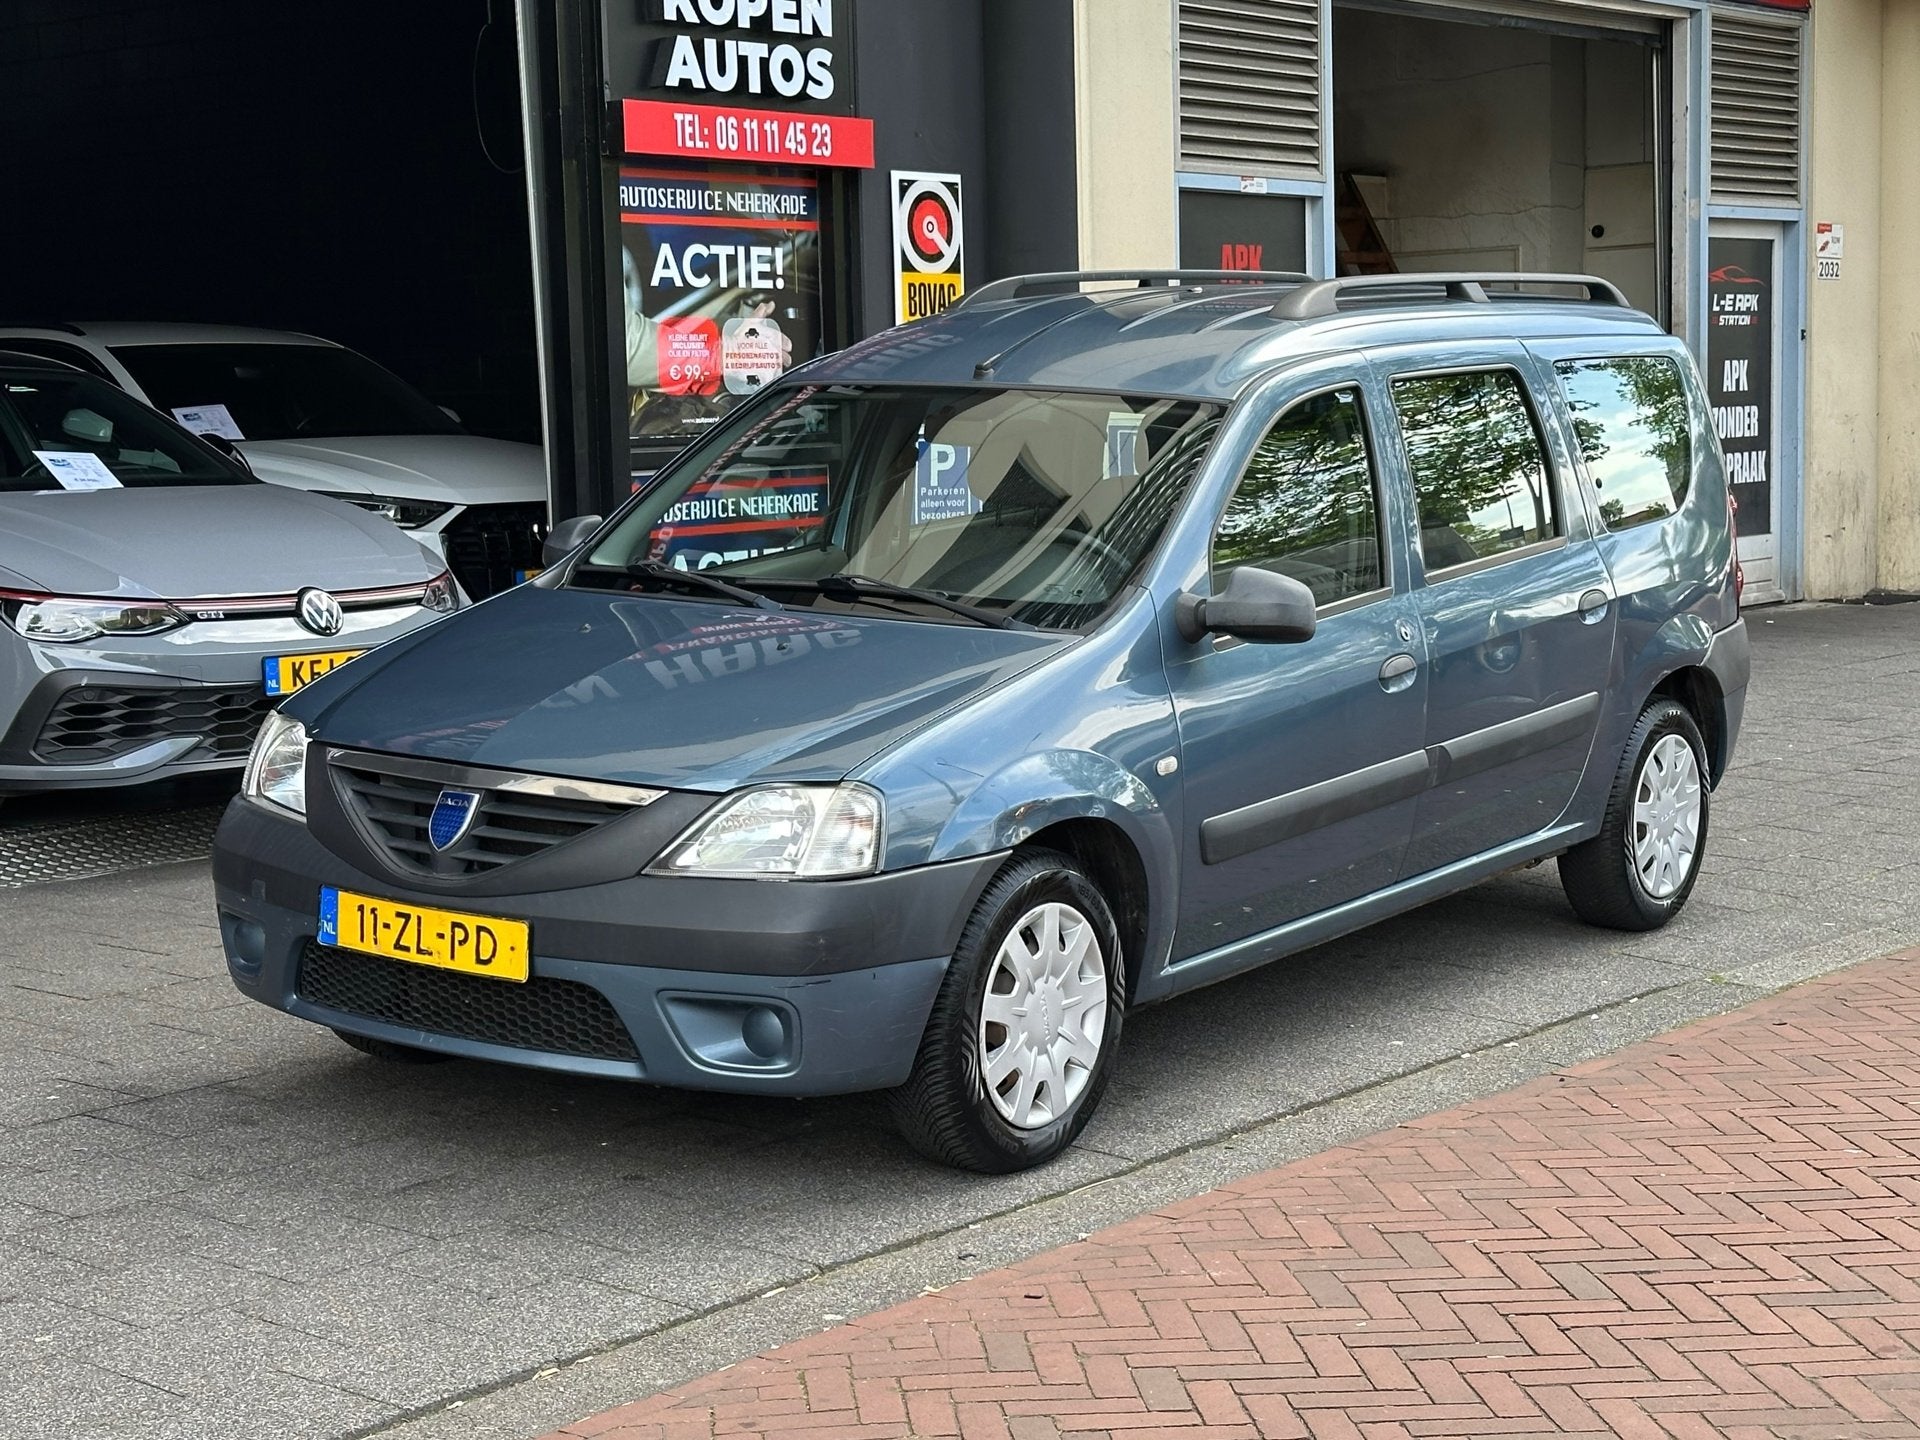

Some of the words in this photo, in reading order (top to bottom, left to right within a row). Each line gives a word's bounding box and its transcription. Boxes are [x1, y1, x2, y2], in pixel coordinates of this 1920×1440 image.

[665, 34, 835, 100] AUTOS
[673, 112, 710, 149] TEL:
[715, 115, 739, 152] 06
[743, 118, 759, 153] 11
[764, 119, 780, 154] 11
[785, 121, 807, 156] 45
[811, 122, 832, 158] 23
[620, 185, 723, 212] AUTOSERVICE
[726, 191, 808, 216] NEHERKADE
[650, 242, 785, 290] ACTIE!
[1221, 243, 1263, 272] APK
[1818, 261, 1840, 278] 2032
[1712, 293, 1734, 312] L-E
[1735, 293, 1760, 312] APK
[1718, 314, 1751, 326] STATION
[669, 365, 682, 381] €
[684, 364, 710, 382] 99,-
[1722, 359, 1749, 393] APK
[930, 443, 956, 487] P
[1724, 450, 1767, 485] PRAAK
[920, 487, 966, 496] Parkeren
[920, 498, 945, 508] alleen
[946, 498, 966, 507] voor
[657, 497, 736, 524] OSERVICE
[740, 492, 819, 517] NEHERKADE
[197, 610, 225, 620] GTI
[267, 679, 279, 689] NL
[291, 655, 354, 688] KE
[440, 797, 470, 808] DACIA
[322, 922, 336, 936] NL
[356, 903, 499, 966] 11-ZL-PD
